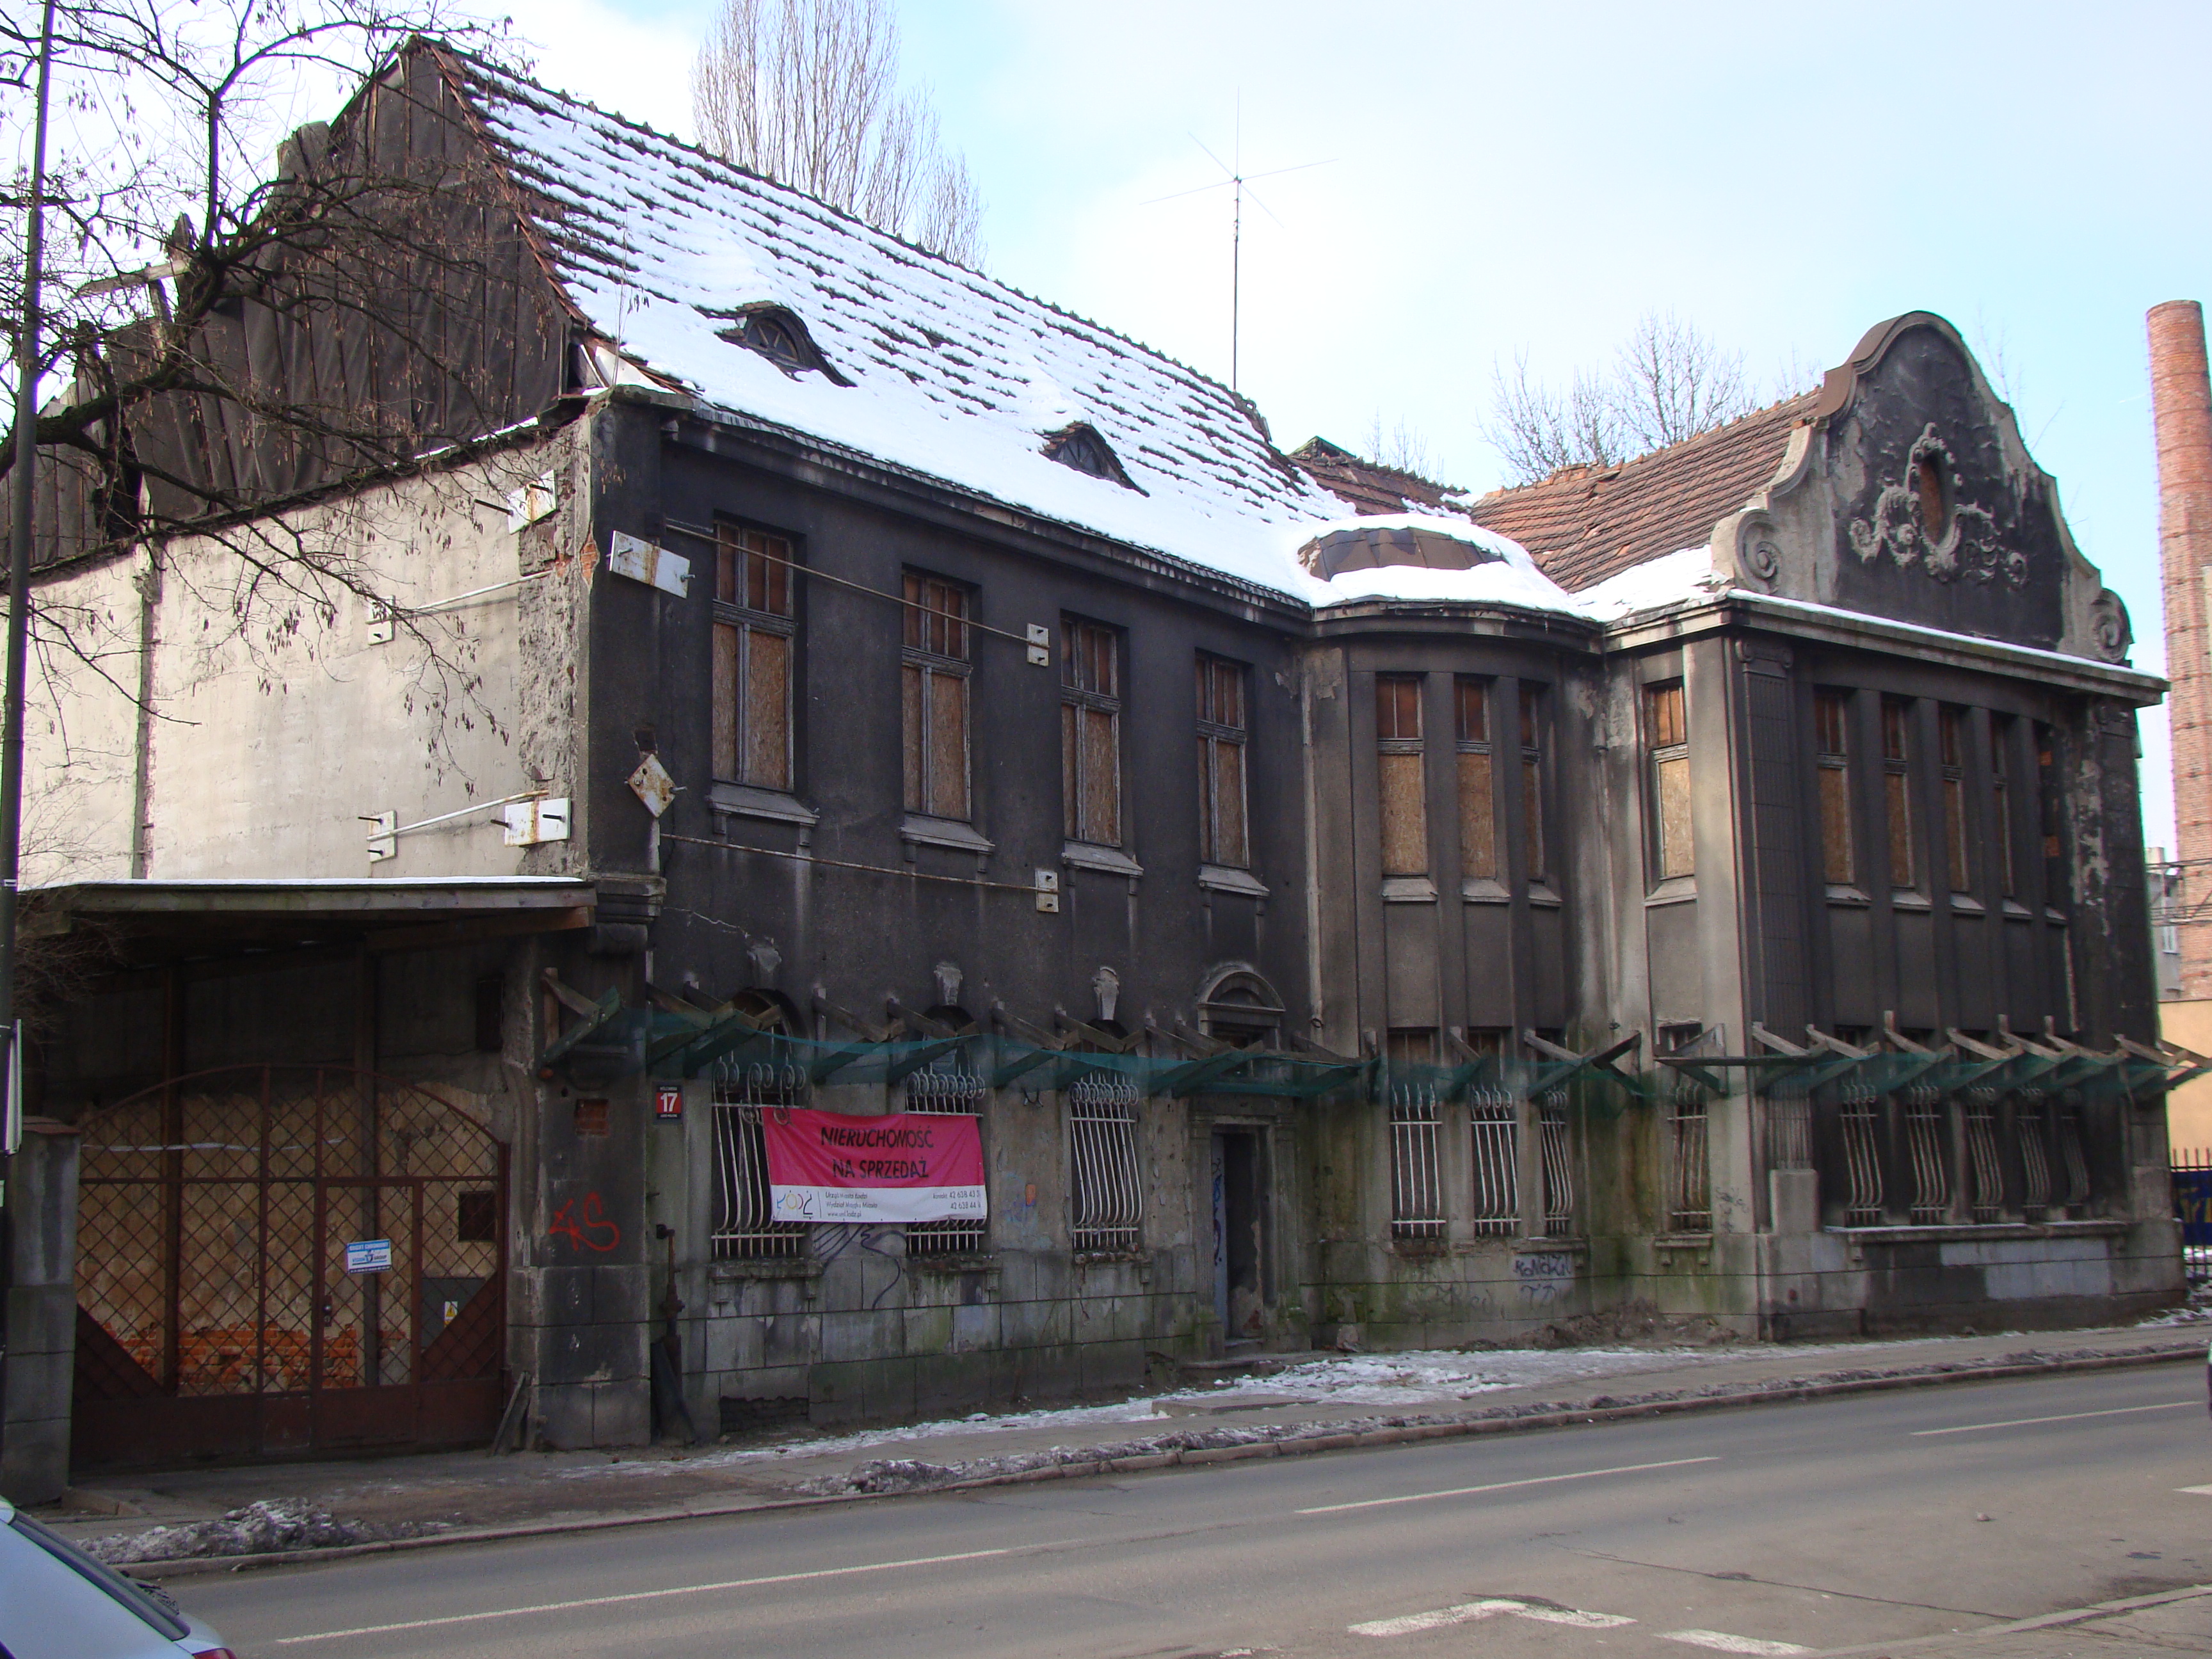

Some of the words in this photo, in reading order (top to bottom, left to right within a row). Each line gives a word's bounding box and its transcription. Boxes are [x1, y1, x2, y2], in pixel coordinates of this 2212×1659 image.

[661, 1093, 678, 1112] 17
[821, 1126, 934, 1148] NIERUCHOMOŚĆ
[833, 1159, 855, 1178] NA
[860, 1157, 929, 1178] SPRZEDAŻ
